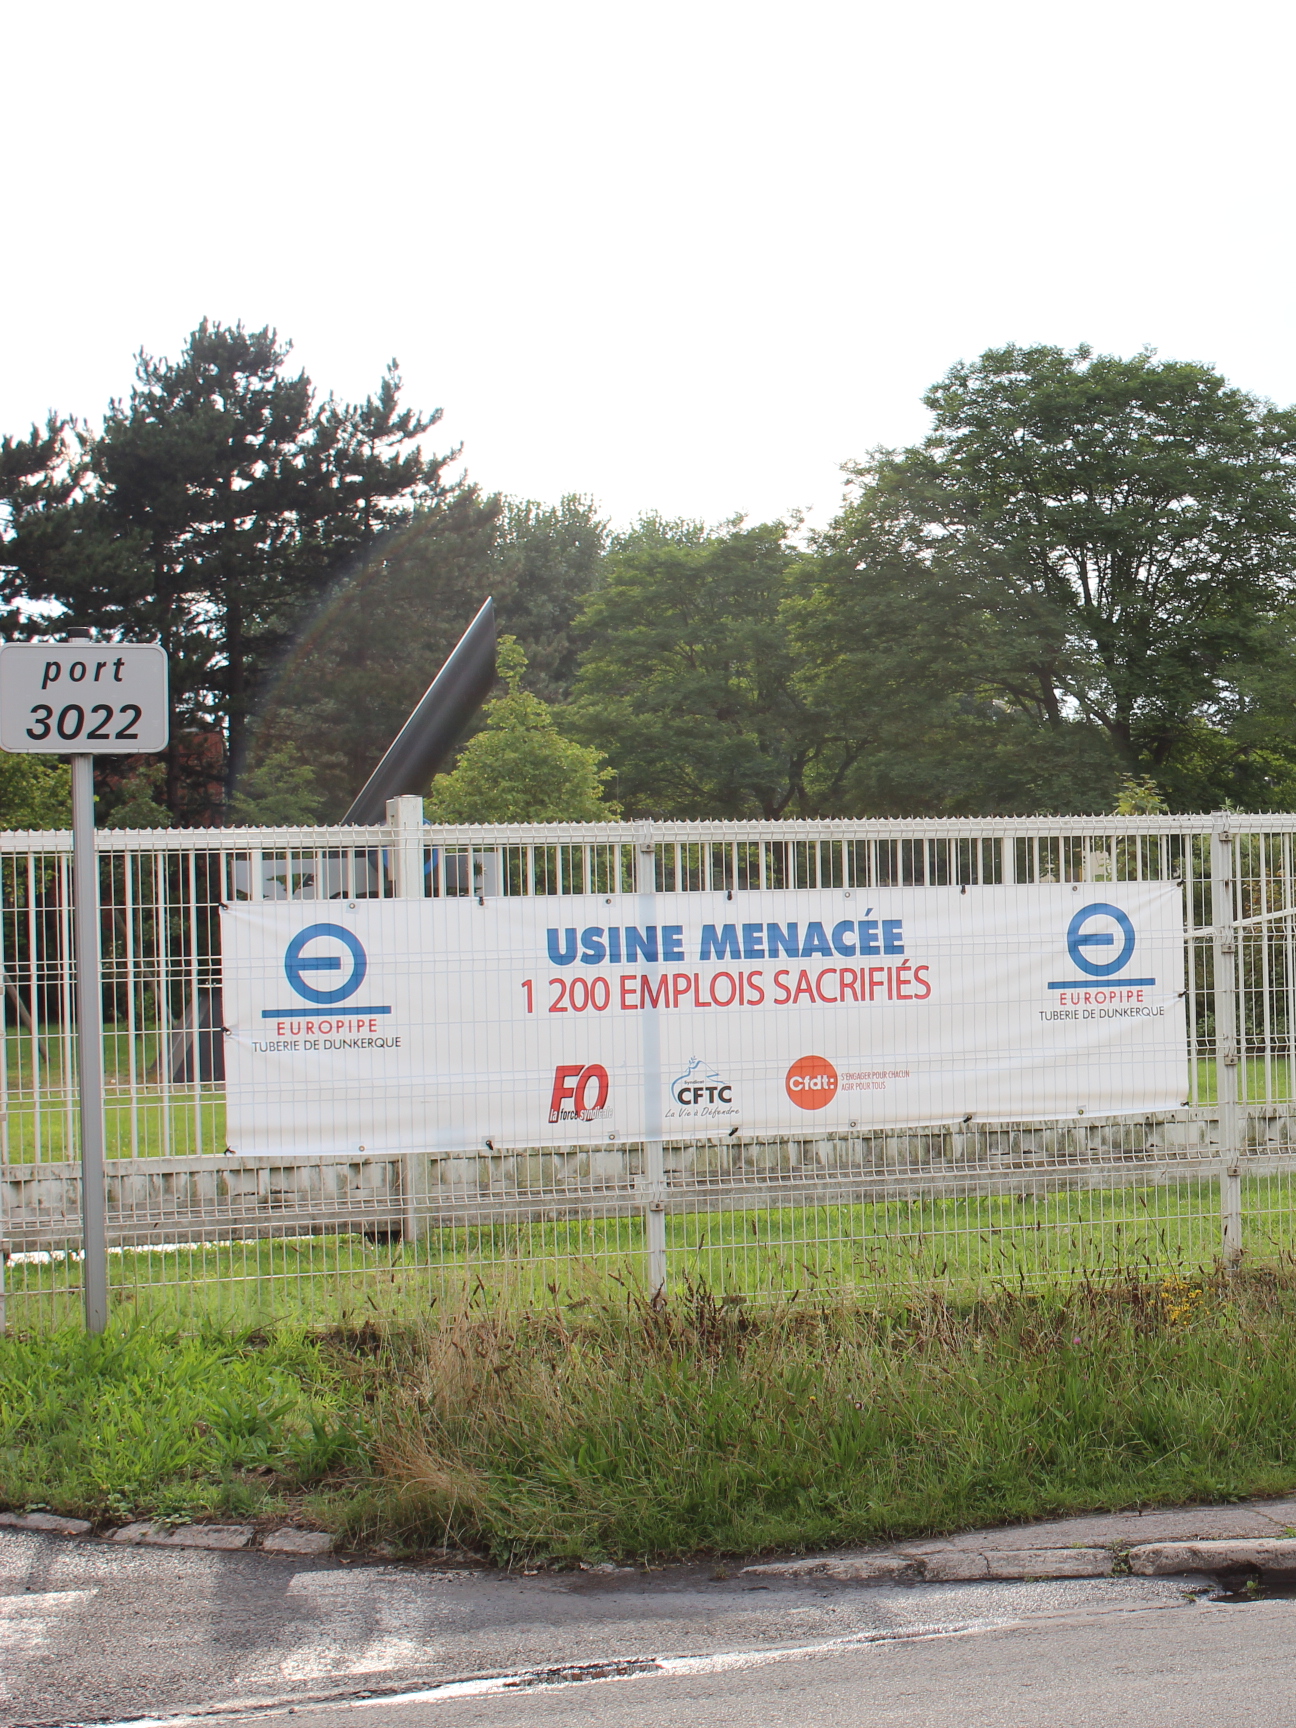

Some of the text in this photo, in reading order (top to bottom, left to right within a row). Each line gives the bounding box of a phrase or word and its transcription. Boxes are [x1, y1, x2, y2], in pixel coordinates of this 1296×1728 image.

[41, 657, 125, 690] port
[26, 703, 142, 741] 3022
[546, 908, 905, 966] USINE MENACÉE
[521, 958, 932, 1014] 1 200 EMPLOIS SACRIFIÉS
[1060, 990, 1144, 1006] EUROPIPE
[1039, 1006, 1164, 1021] TUBERIE DE DUNKERQUE
[277, 1019, 378, 1036] EUROPIPE
[252, 1037, 402, 1052] TUBERIE DE DUNKERQUE
[841, 1070, 910, 1081] S'ENGAGER POUR CHACUN
[548, 1064, 609, 1123] FO
[841, 1081, 886, 1092] AGIR POUR TOUS
[677, 1085, 732, 1105] CFTC
[560, 1108, 578, 1120] force
[665, 1109, 675, 1118] La
[679, 1108, 691, 1118] Vie
[701, 1106, 740, 1118] Défendre
